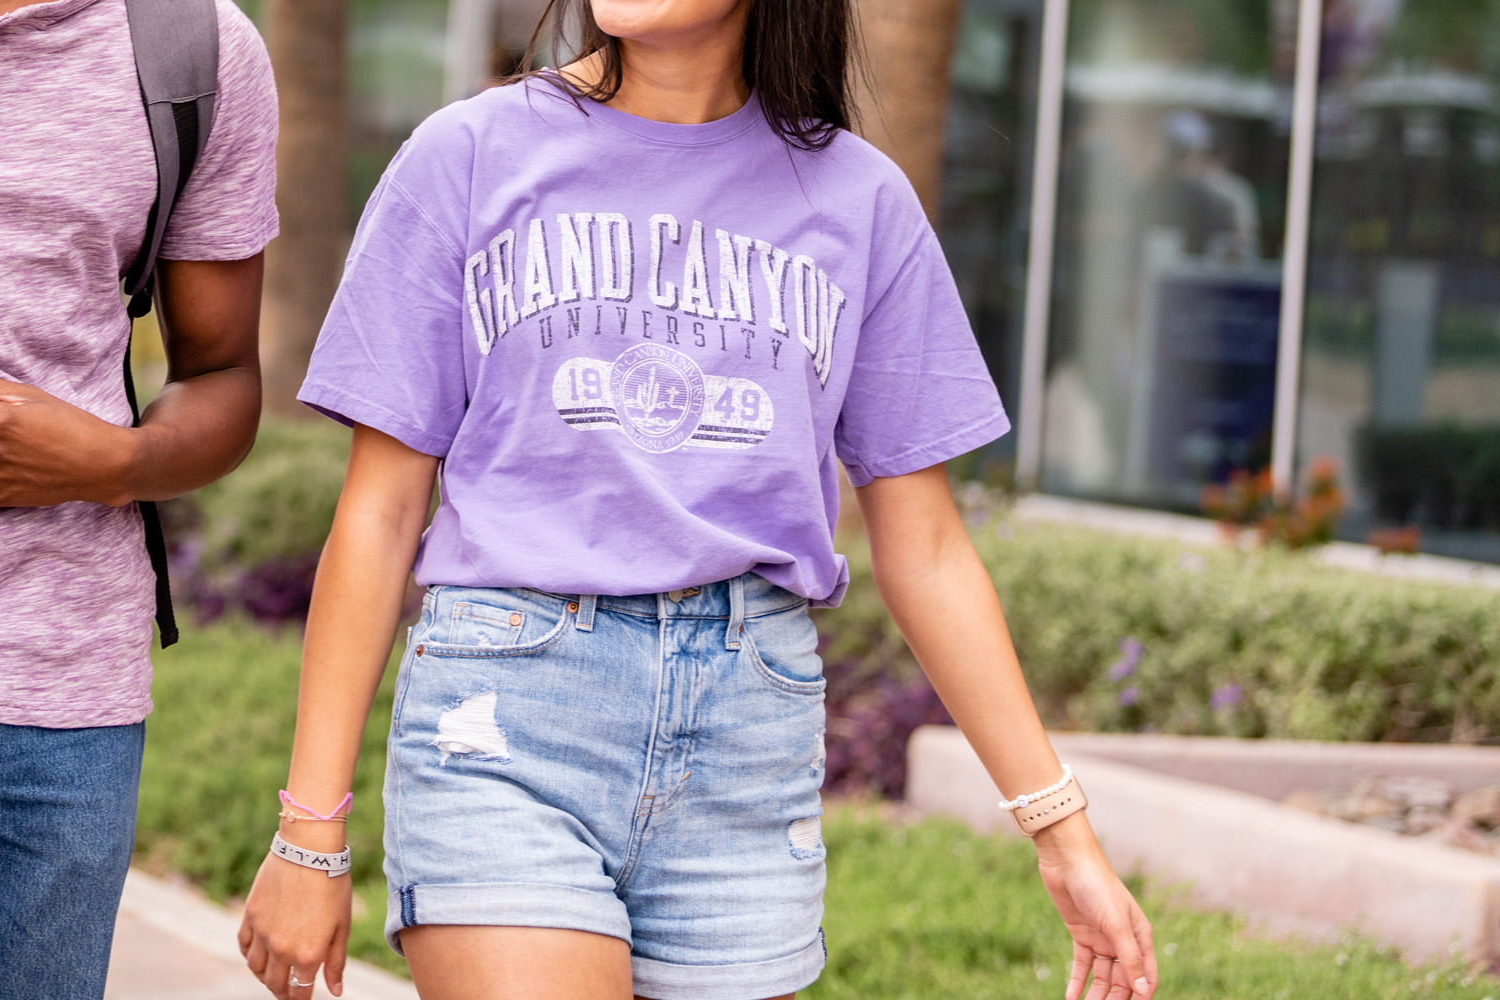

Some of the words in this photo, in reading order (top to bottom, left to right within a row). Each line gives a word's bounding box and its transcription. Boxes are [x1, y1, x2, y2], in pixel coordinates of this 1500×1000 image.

[464, 212, 635, 356] GRAND
[647, 213, 847, 391] CANYON
[538, 305, 781, 371] UNIVERSITY
[568, 367, 603, 400] 19
[713, 386, 761, 421] 49
[671, 353, 704, 418] UNIVERSITY
